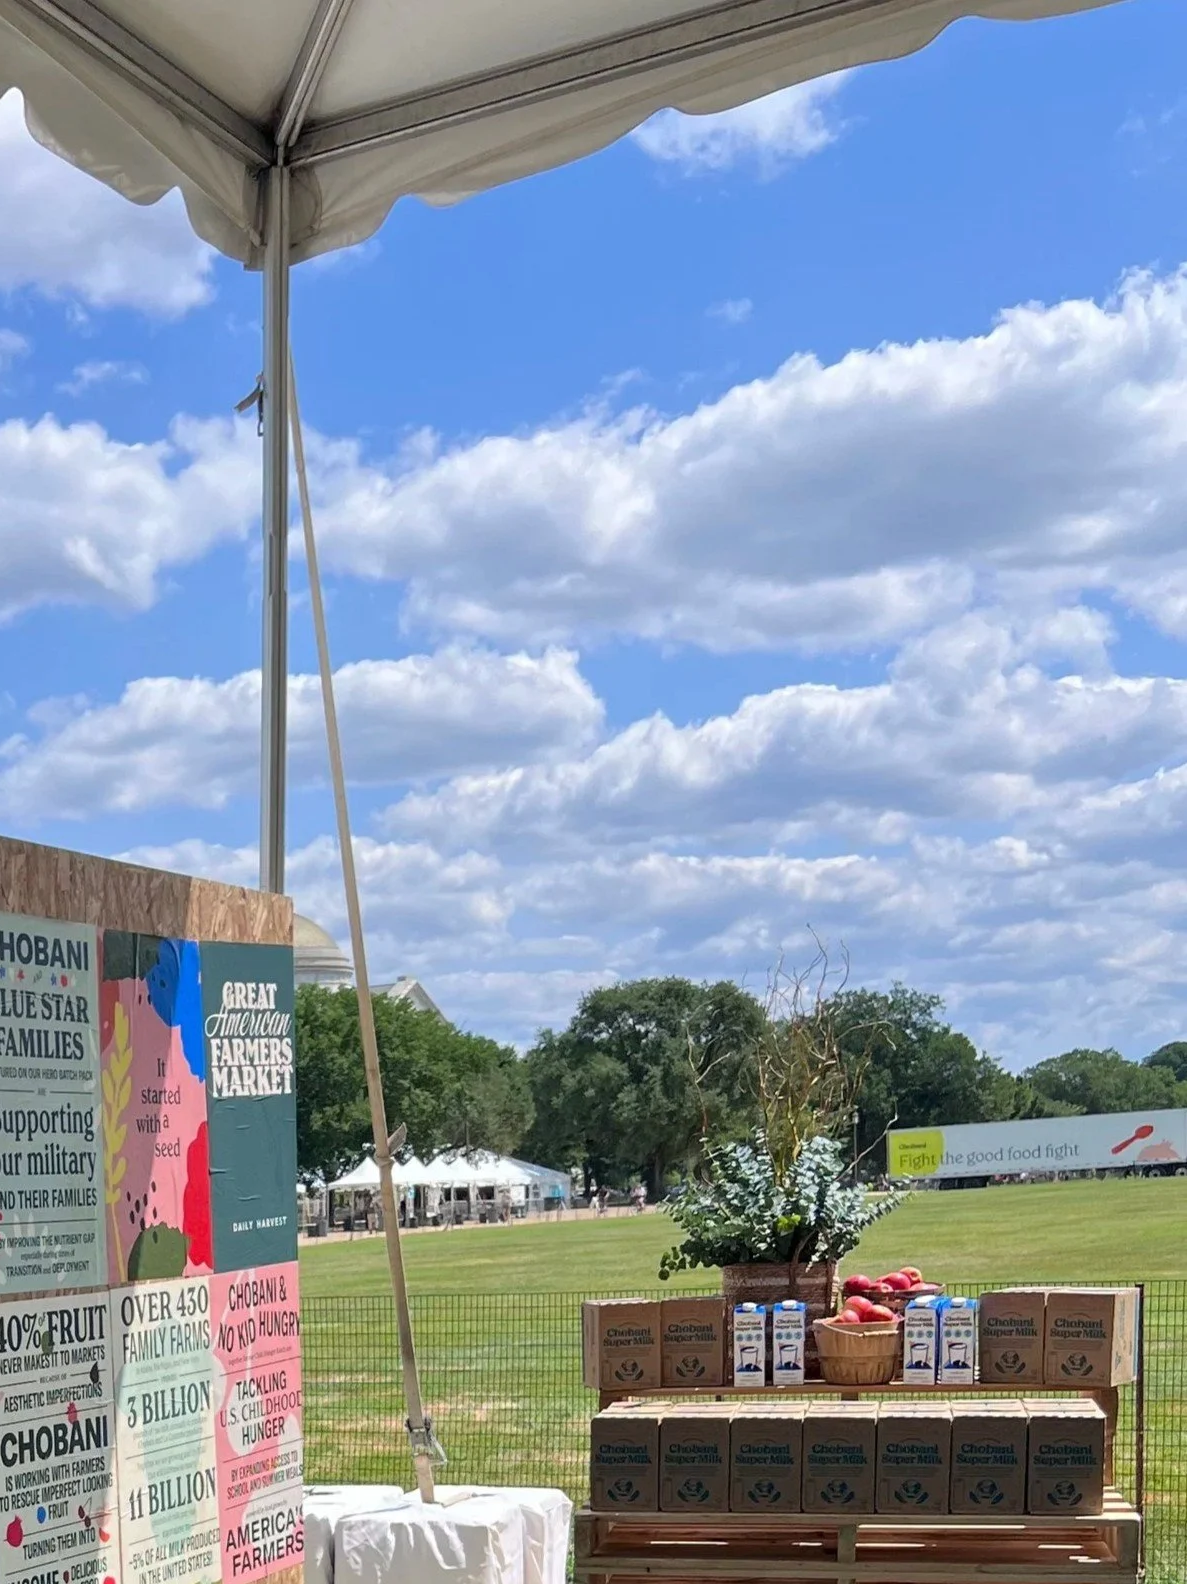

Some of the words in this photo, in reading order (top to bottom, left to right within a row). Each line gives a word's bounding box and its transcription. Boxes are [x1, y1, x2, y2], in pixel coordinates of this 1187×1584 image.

[40, 992, 90, 1025] STAR
[222, 981, 278, 1010] GREAT
[204, 1006, 292, 1038] American
[210, 1036, 293, 1066] FARMERS
[157, 1057, 166, 1078] It
[212, 1064, 293, 1098] MARKET
[141, 1085, 181, 1106] started
[136, 1114, 161, 1134] with
[162, 1114, 169, 1129] a
[27, 1144, 97, 1182] military
[154, 1141, 181, 1158] seed
[899, 1152, 937, 1170] Fight
[940, 1151, 963, 1166] the
[967, 1148, 1003, 1167] good
[1008, 1145, 1042, 1160] food
[1045, 1143, 1079, 1160] fight
[232, 1219, 254, 1233] DAILY
[256, 1216, 287, 1230] HARVEST
[121, 1291, 172, 1327] OVER
[176, 1285, 208, 1317] 430
[664, 1332, 691, 1343] Super
[691, 1330, 717, 1342] Milk
[668, 1323, 713, 1334] Chobani
[982, 1327, 1014, 1338] Super
[1015, 1327, 1038, 1337] Milk
[987, 1317, 1035, 1328] Chobani
[123, 1326, 166, 1364] FAMILY
[170, 1319, 210, 1355] FARMS
[236, 1370, 287, 1399] TACKLING
[127, 1395, 137, 1428] 3
[142, 1380, 211, 1425] BILLION
[0, 1415, 108, 1468] CHOBANI
[242, 1417, 285, 1446] HUNGER
